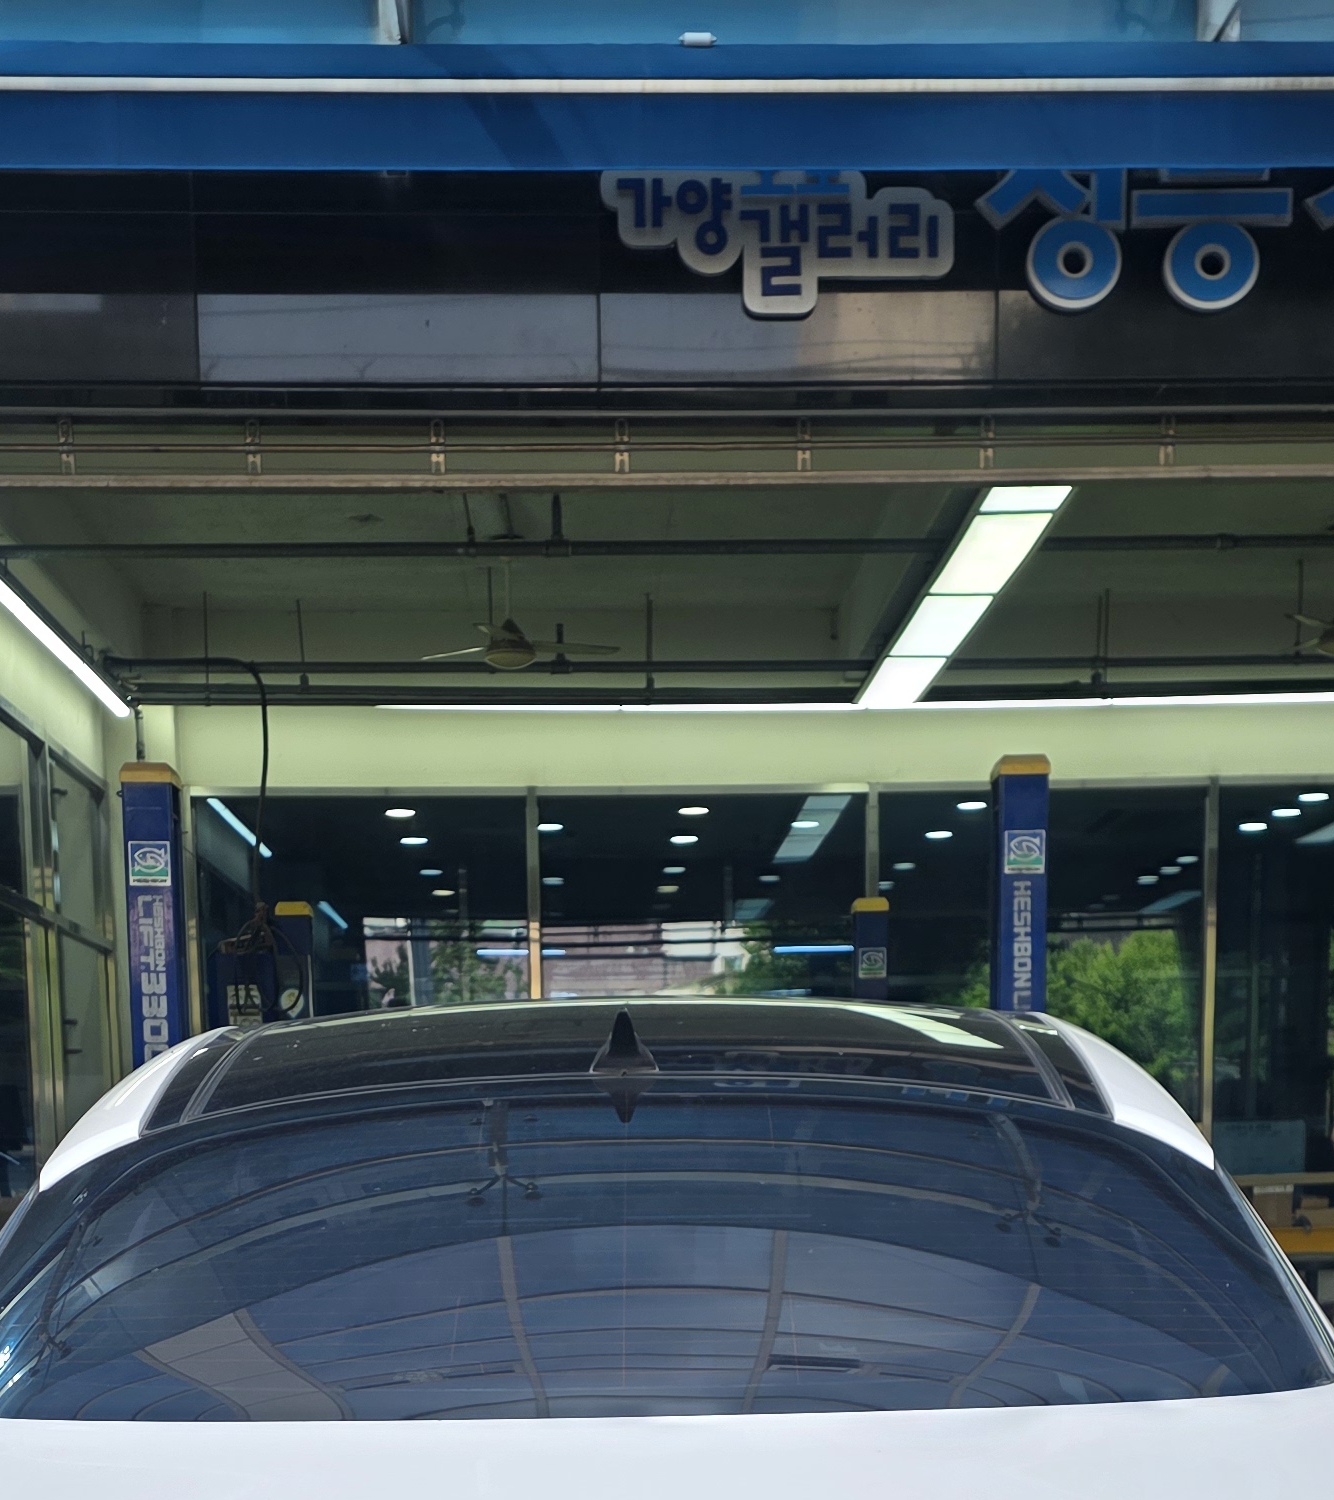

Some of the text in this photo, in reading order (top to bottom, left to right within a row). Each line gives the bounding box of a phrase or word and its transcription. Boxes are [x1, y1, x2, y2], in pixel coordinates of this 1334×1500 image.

[616, 176, 734, 256] 가양
[739, 202, 940, 297] 갤러리
[151, 895, 167, 971] HESHBON
[1012, 880, 1032, 988] HESHBON
